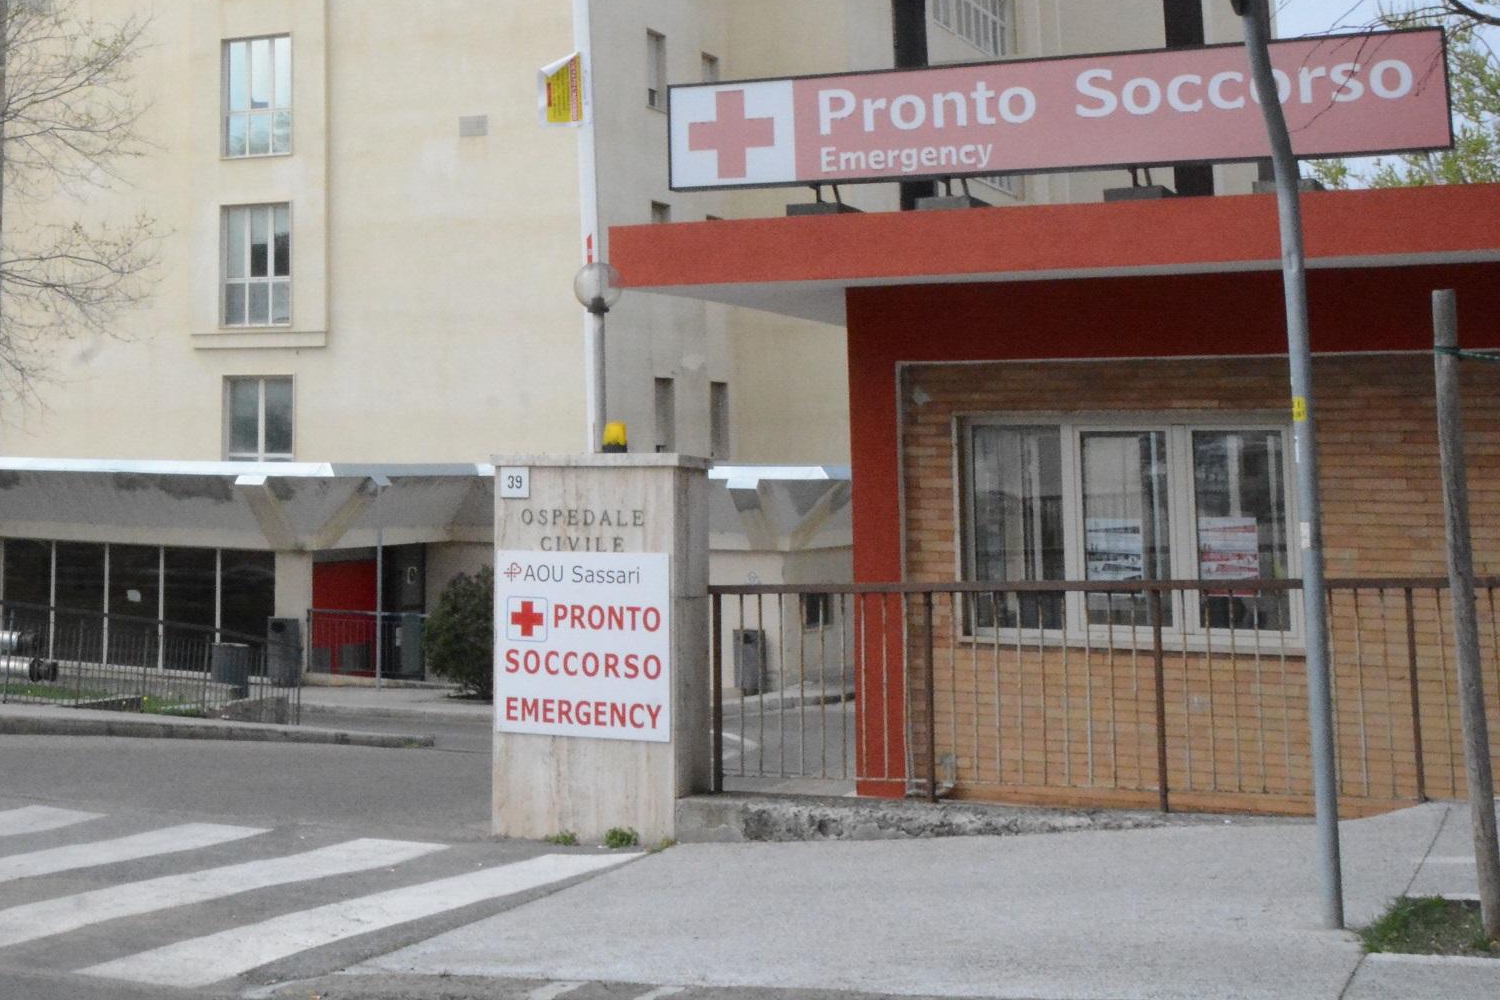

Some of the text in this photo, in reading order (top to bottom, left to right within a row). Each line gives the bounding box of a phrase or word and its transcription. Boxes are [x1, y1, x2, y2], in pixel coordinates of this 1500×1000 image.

[817, 58, 1414, 136] Pronto Soccorso
[819, 143, 993, 173] Emergency
[507, 475, 523, 489] 39
[521, 508, 645, 527] OSPEDALE
[540, 536, 625, 552] CIVILE
[523, 564, 641, 585] AOU Sassari
[553, 603, 661, 633] PRONTO
[505, 648, 662, 681] SOCCORSO
[505, 696, 662, 730] EMERGENCY
